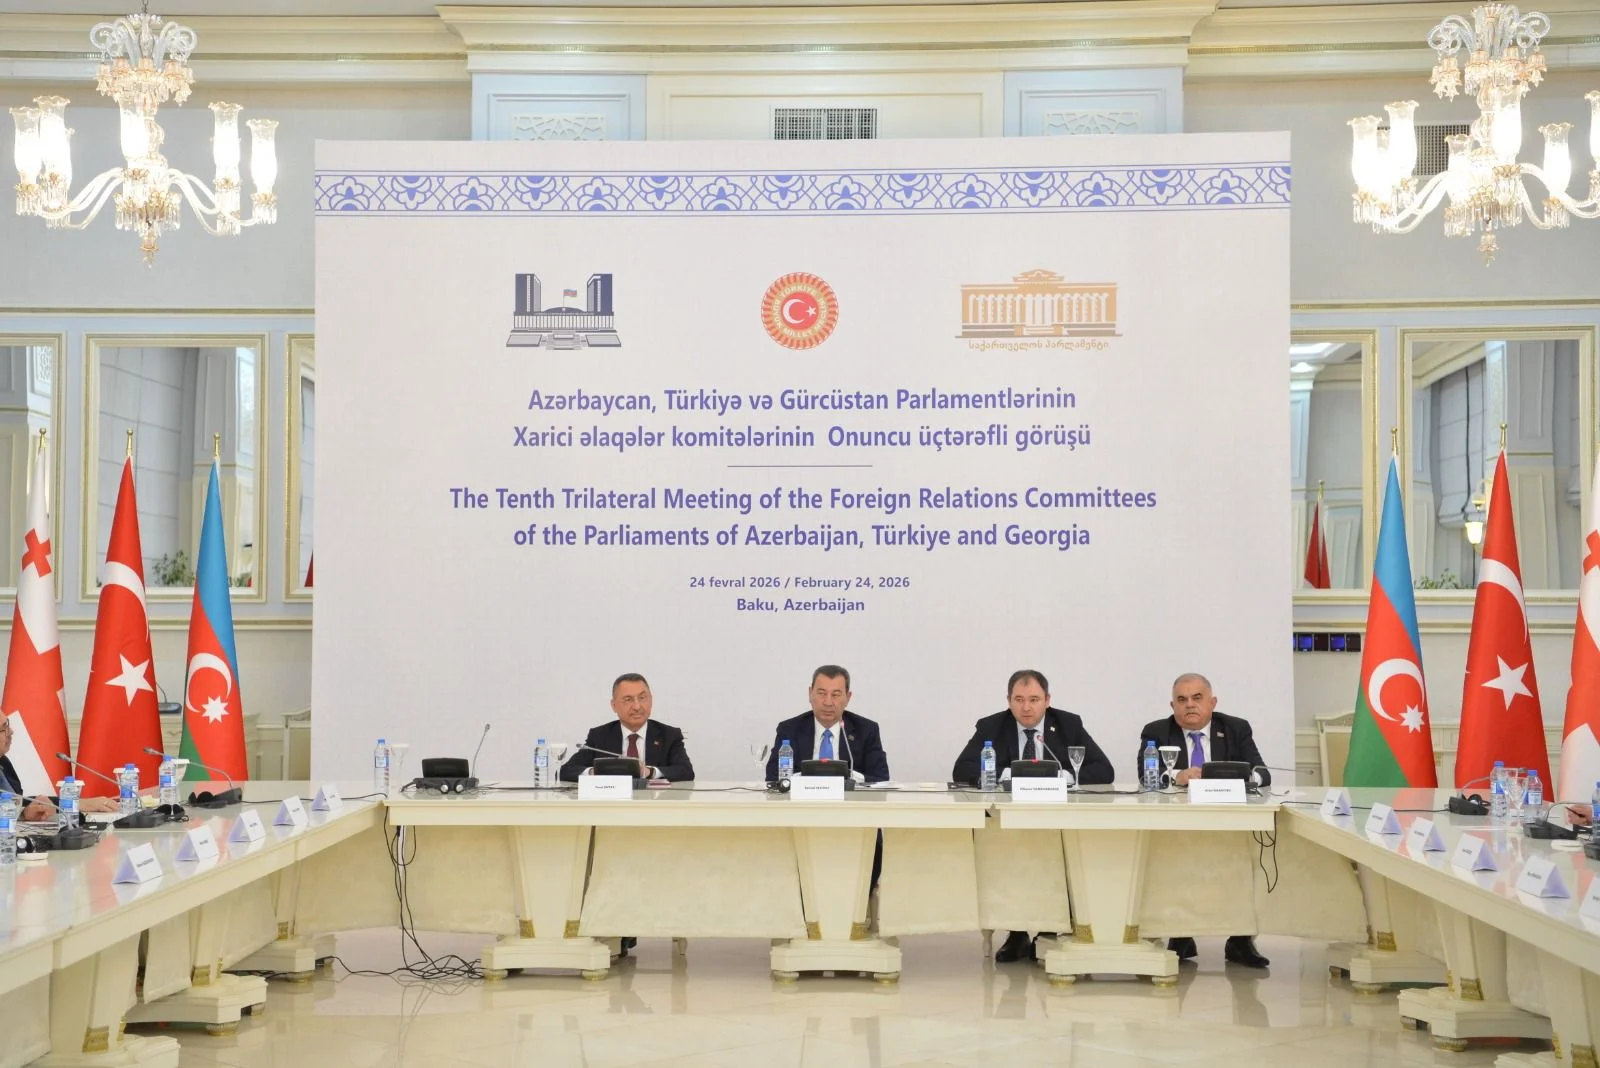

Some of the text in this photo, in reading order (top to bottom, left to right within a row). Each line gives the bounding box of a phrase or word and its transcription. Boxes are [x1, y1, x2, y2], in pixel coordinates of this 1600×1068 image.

[968, 339, 1109, 352] საქართველოს პარლამენტი
[528, 387, 1076, 416] Azərbaycan, Türkiyə və Gürcüstan Parlamentlərinin
[514, 424, 1091, 452] Xarici əlaqələr komitələrinin Onuncu üçtərəfli görüşü
[450, 486, 1157, 515] The Tenth Trilateral Meeting of the Foreign Relations Committees
[514, 524, 1090, 551] of the Parliaments of Azerbaijan, Türkiye and Georgia
[690, 577, 705, 588] 24
[709, 576, 745, 588] fevral
[749, 577, 781, 588] 2026
[794, 576, 851, 590] February
[855, 577, 874, 590] 24,
[878, 577, 910, 588] 2026
[737, 597, 865, 614] Baku, Azerbaijan
